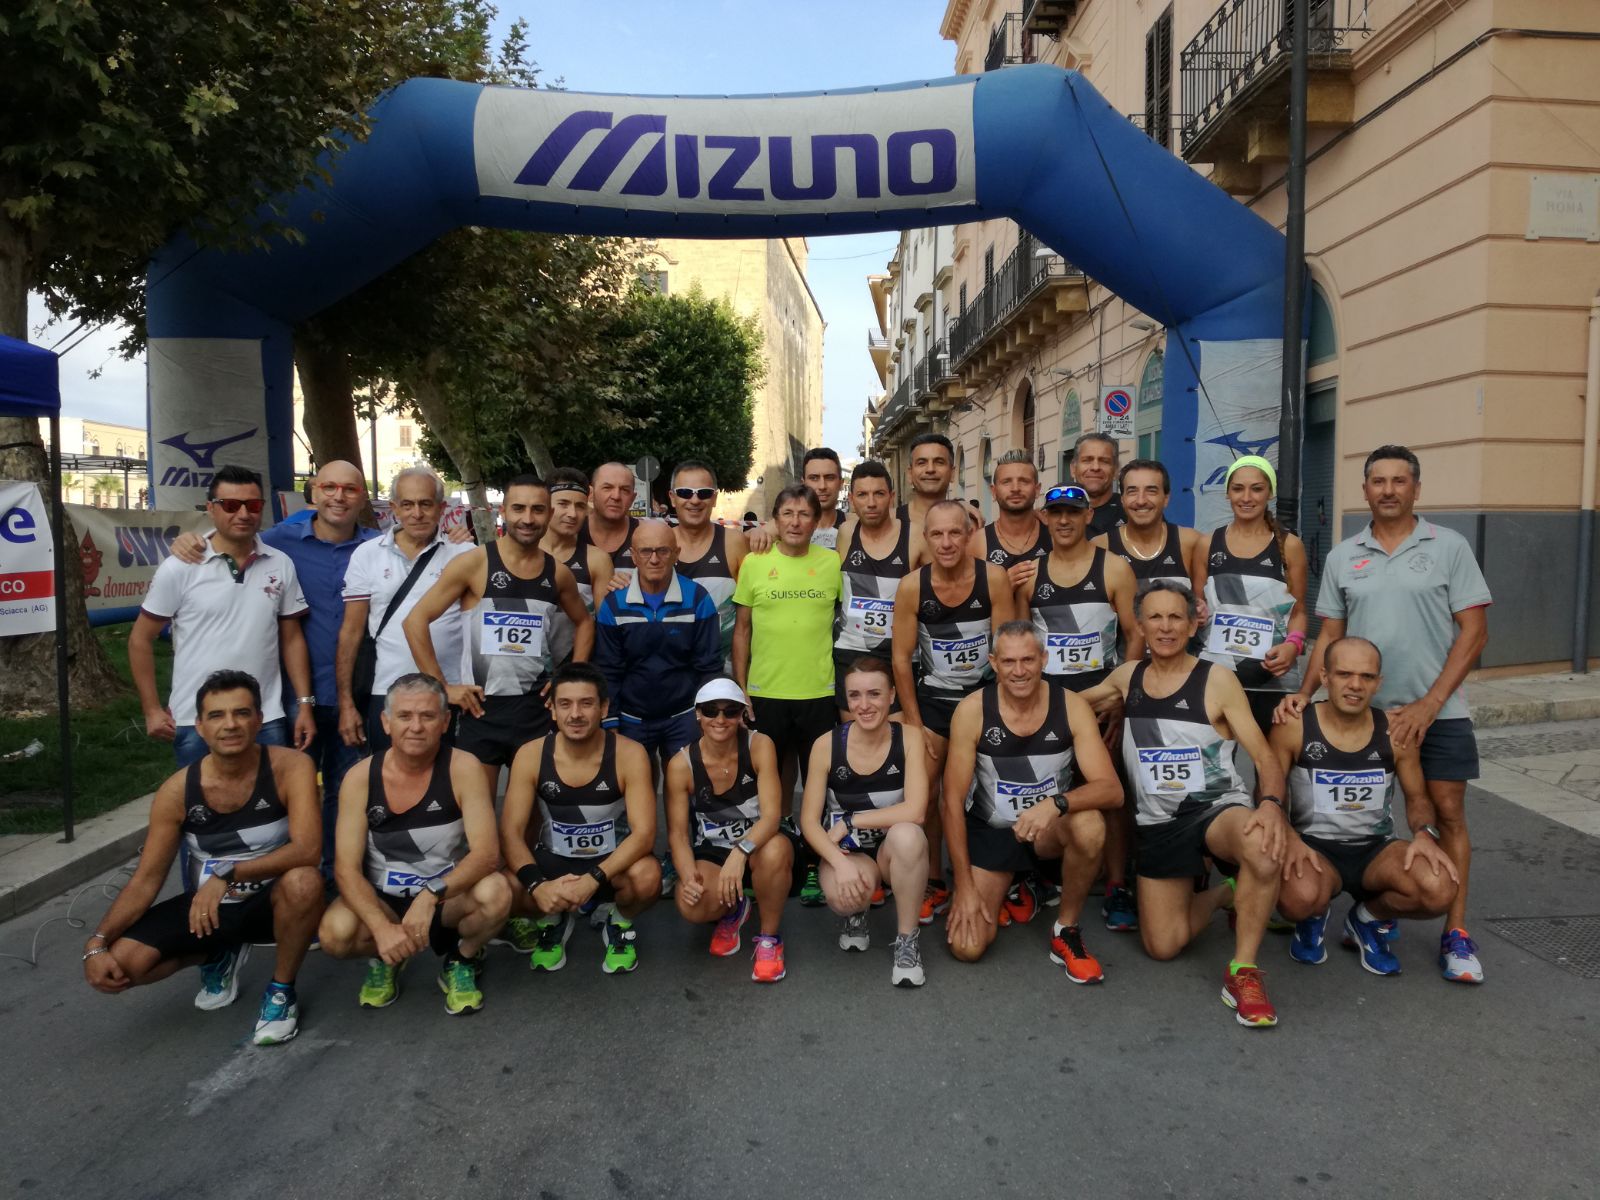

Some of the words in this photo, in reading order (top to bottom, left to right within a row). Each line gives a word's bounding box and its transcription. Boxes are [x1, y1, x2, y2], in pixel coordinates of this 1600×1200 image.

[104, 576, 145, 598] donare
[0, 606, 28, 615] Sciacca
[31, 604, 49, 614] (AG)
[864, 612, 887, 626] 53
[494, 627, 532, 644] 162
[1222, 628, 1261, 646] 153
[944, 649, 979, 665] 145
[1057, 647, 1092, 663] 157
[1150, 764, 1191, 780] 155
[1328, 786, 1373, 802] 152
[563, 834, 604, 849] 160
